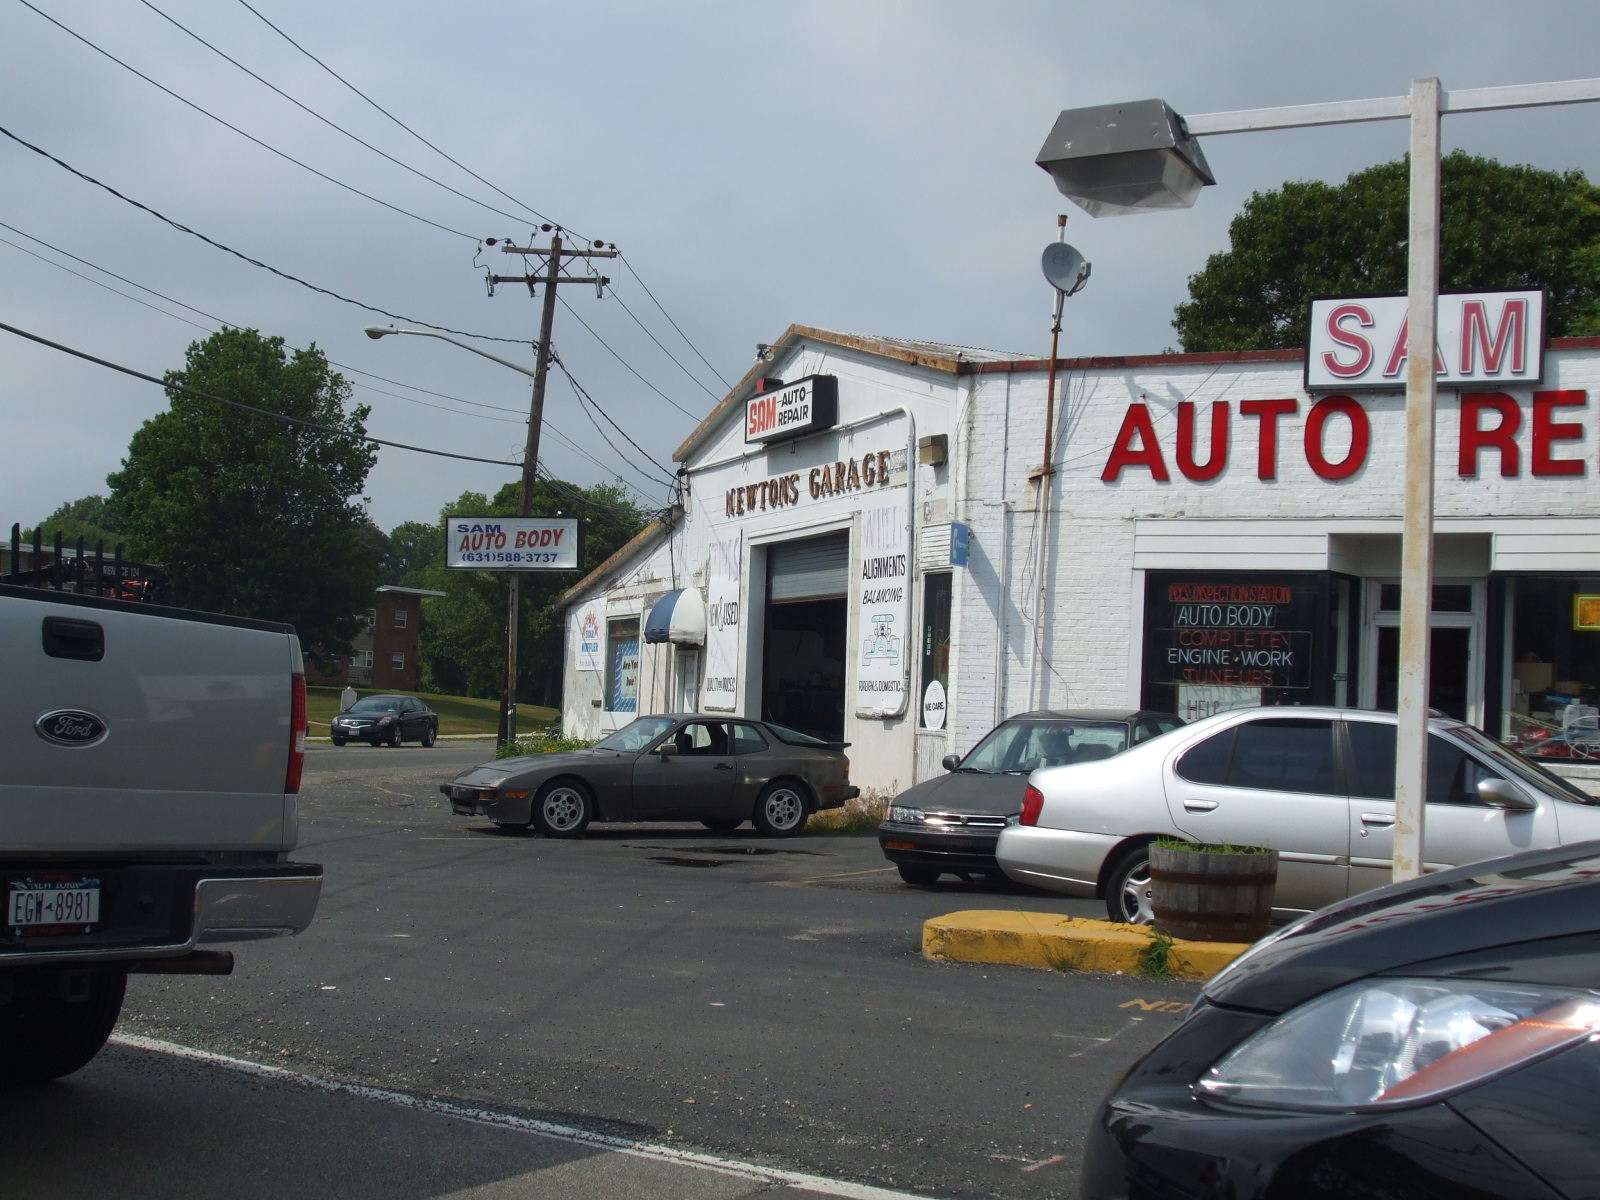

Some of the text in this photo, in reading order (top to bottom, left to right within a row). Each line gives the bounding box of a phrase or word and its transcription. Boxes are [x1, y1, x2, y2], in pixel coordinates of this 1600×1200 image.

[781, 386, 807, 408] AUTO
[749, 396, 777, 435] SAM
[777, 404, 809, 427] REPAIR
[1101, 389, 1600, 482] AUTO RE
[725, 450, 891, 517] NEWTONS GARAGE
[457, 524, 501, 533] SAM
[459, 528, 565, 552] AUTO BODY
[462, 552, 558, 563] (631)588-3737
[862, 554, 906, 580] ALIGNMENTS
[862, 587, 903, 605] BALANCING
[1192, 584, 1249, 602] INSPECTION
[1250, 585, 1291, 602] STATION
[723, 602, 739, 626] USED
[1177, 605, 1273, 626] AUTO BODY
[1179, 630, 1282, 648] COMPLETE
[1167, 648, 1293, 666] ENGINE WORK
[878, 680, 900, 691] DOMESTIC
[1183, 668, 1274, 686] TUNE-UPS
[53, 715, 93, 737] Ford
[55, 891, 91, 922] 8981
